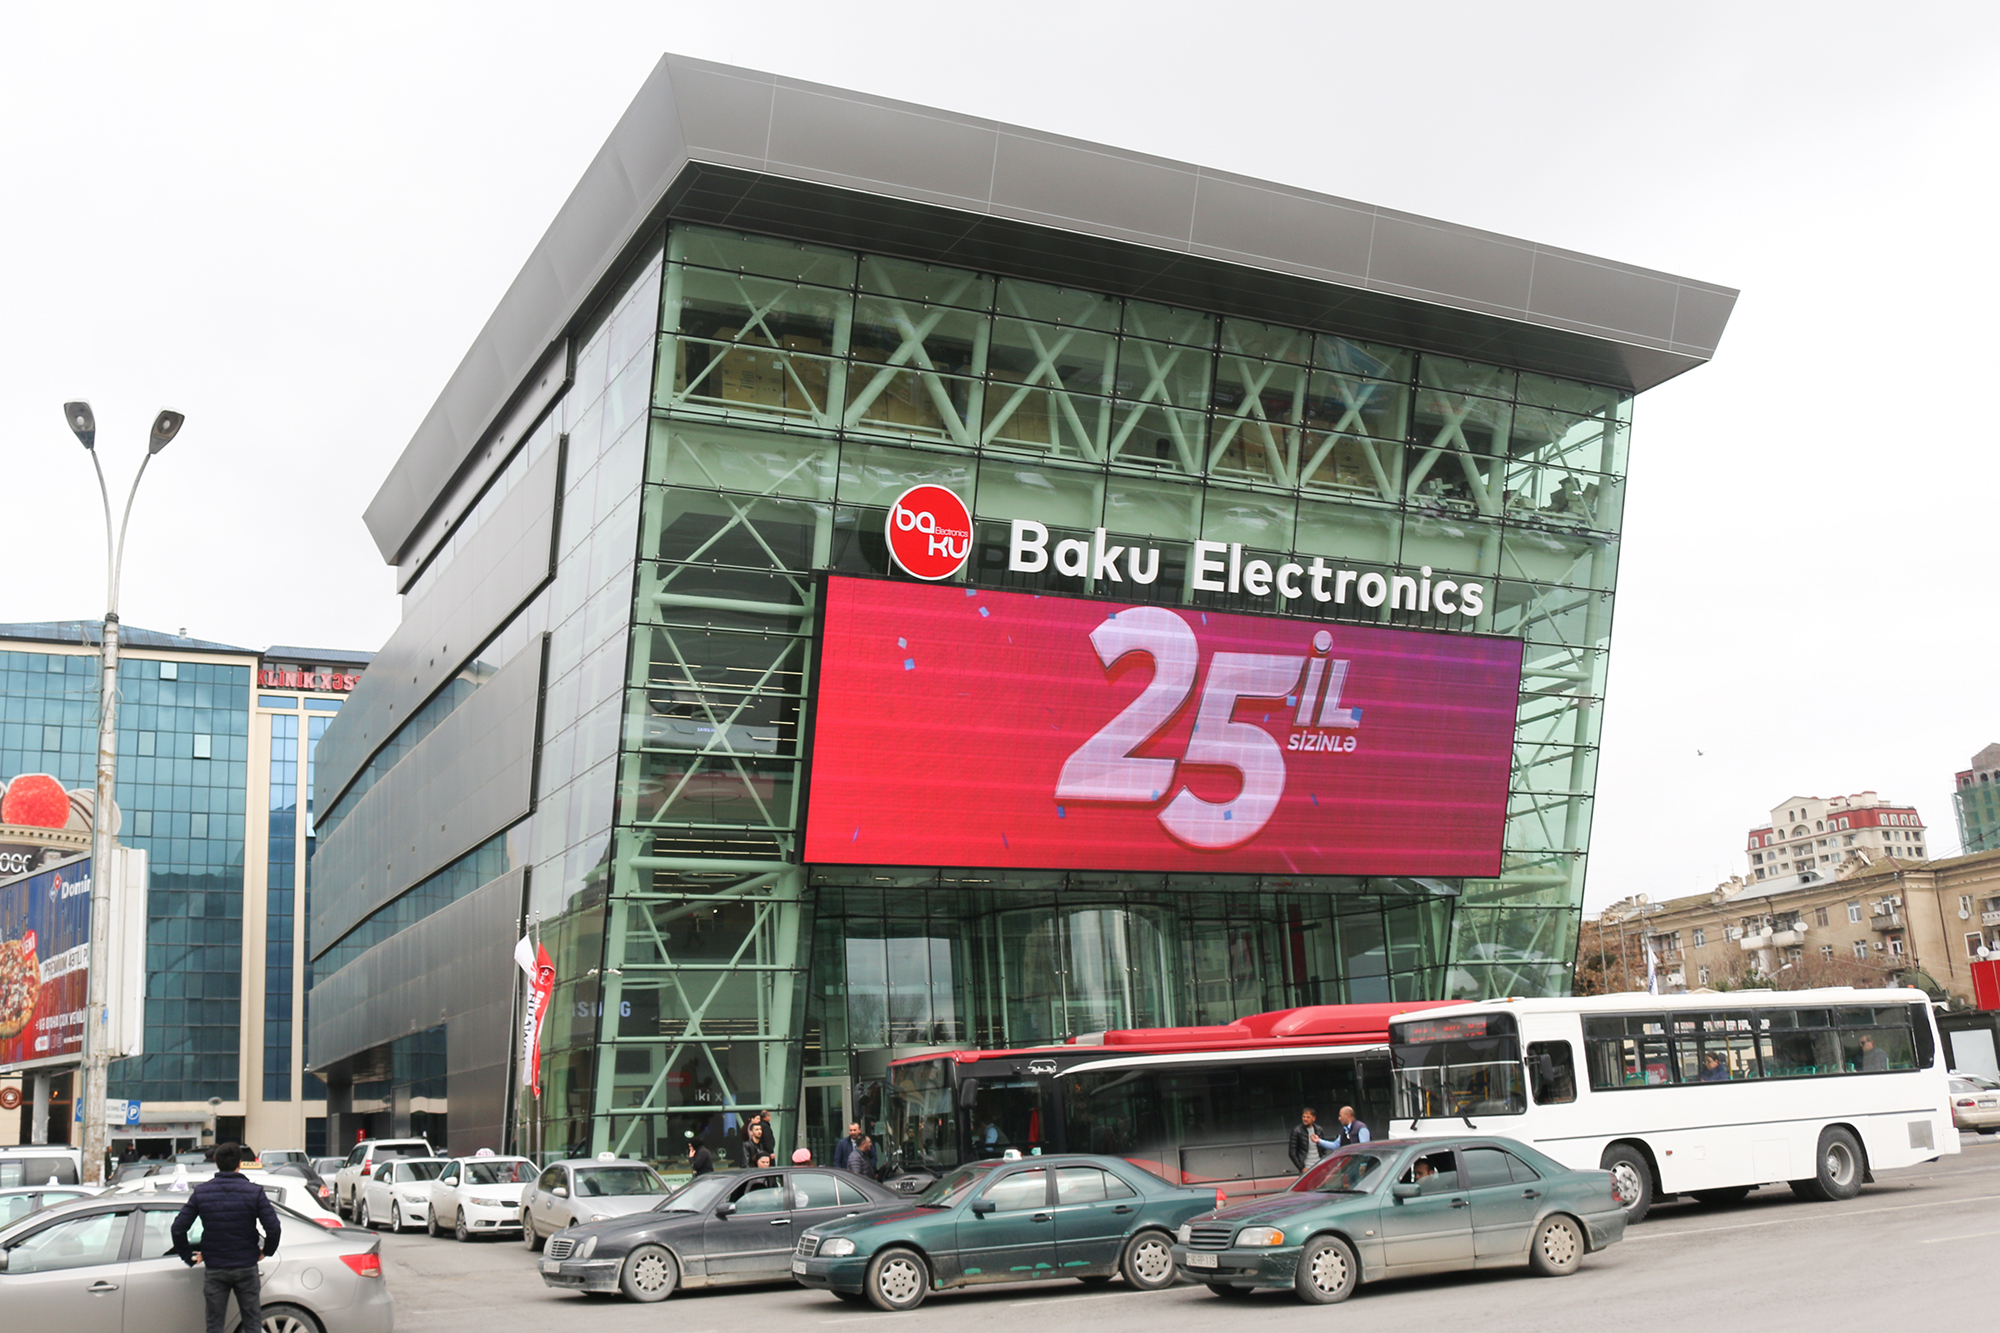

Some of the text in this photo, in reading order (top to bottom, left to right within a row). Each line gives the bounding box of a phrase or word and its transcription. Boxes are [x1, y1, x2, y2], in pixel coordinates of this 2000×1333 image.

[935, 526, 969, 538] Electronics
[1009, 519, 1484, 617] Baku Electronics
[258, 666, 315, 689] KLİNİK
[1054, 606, 1306, 848] 25
[1287, 730, 1357, 752] SİZİNLƏ
